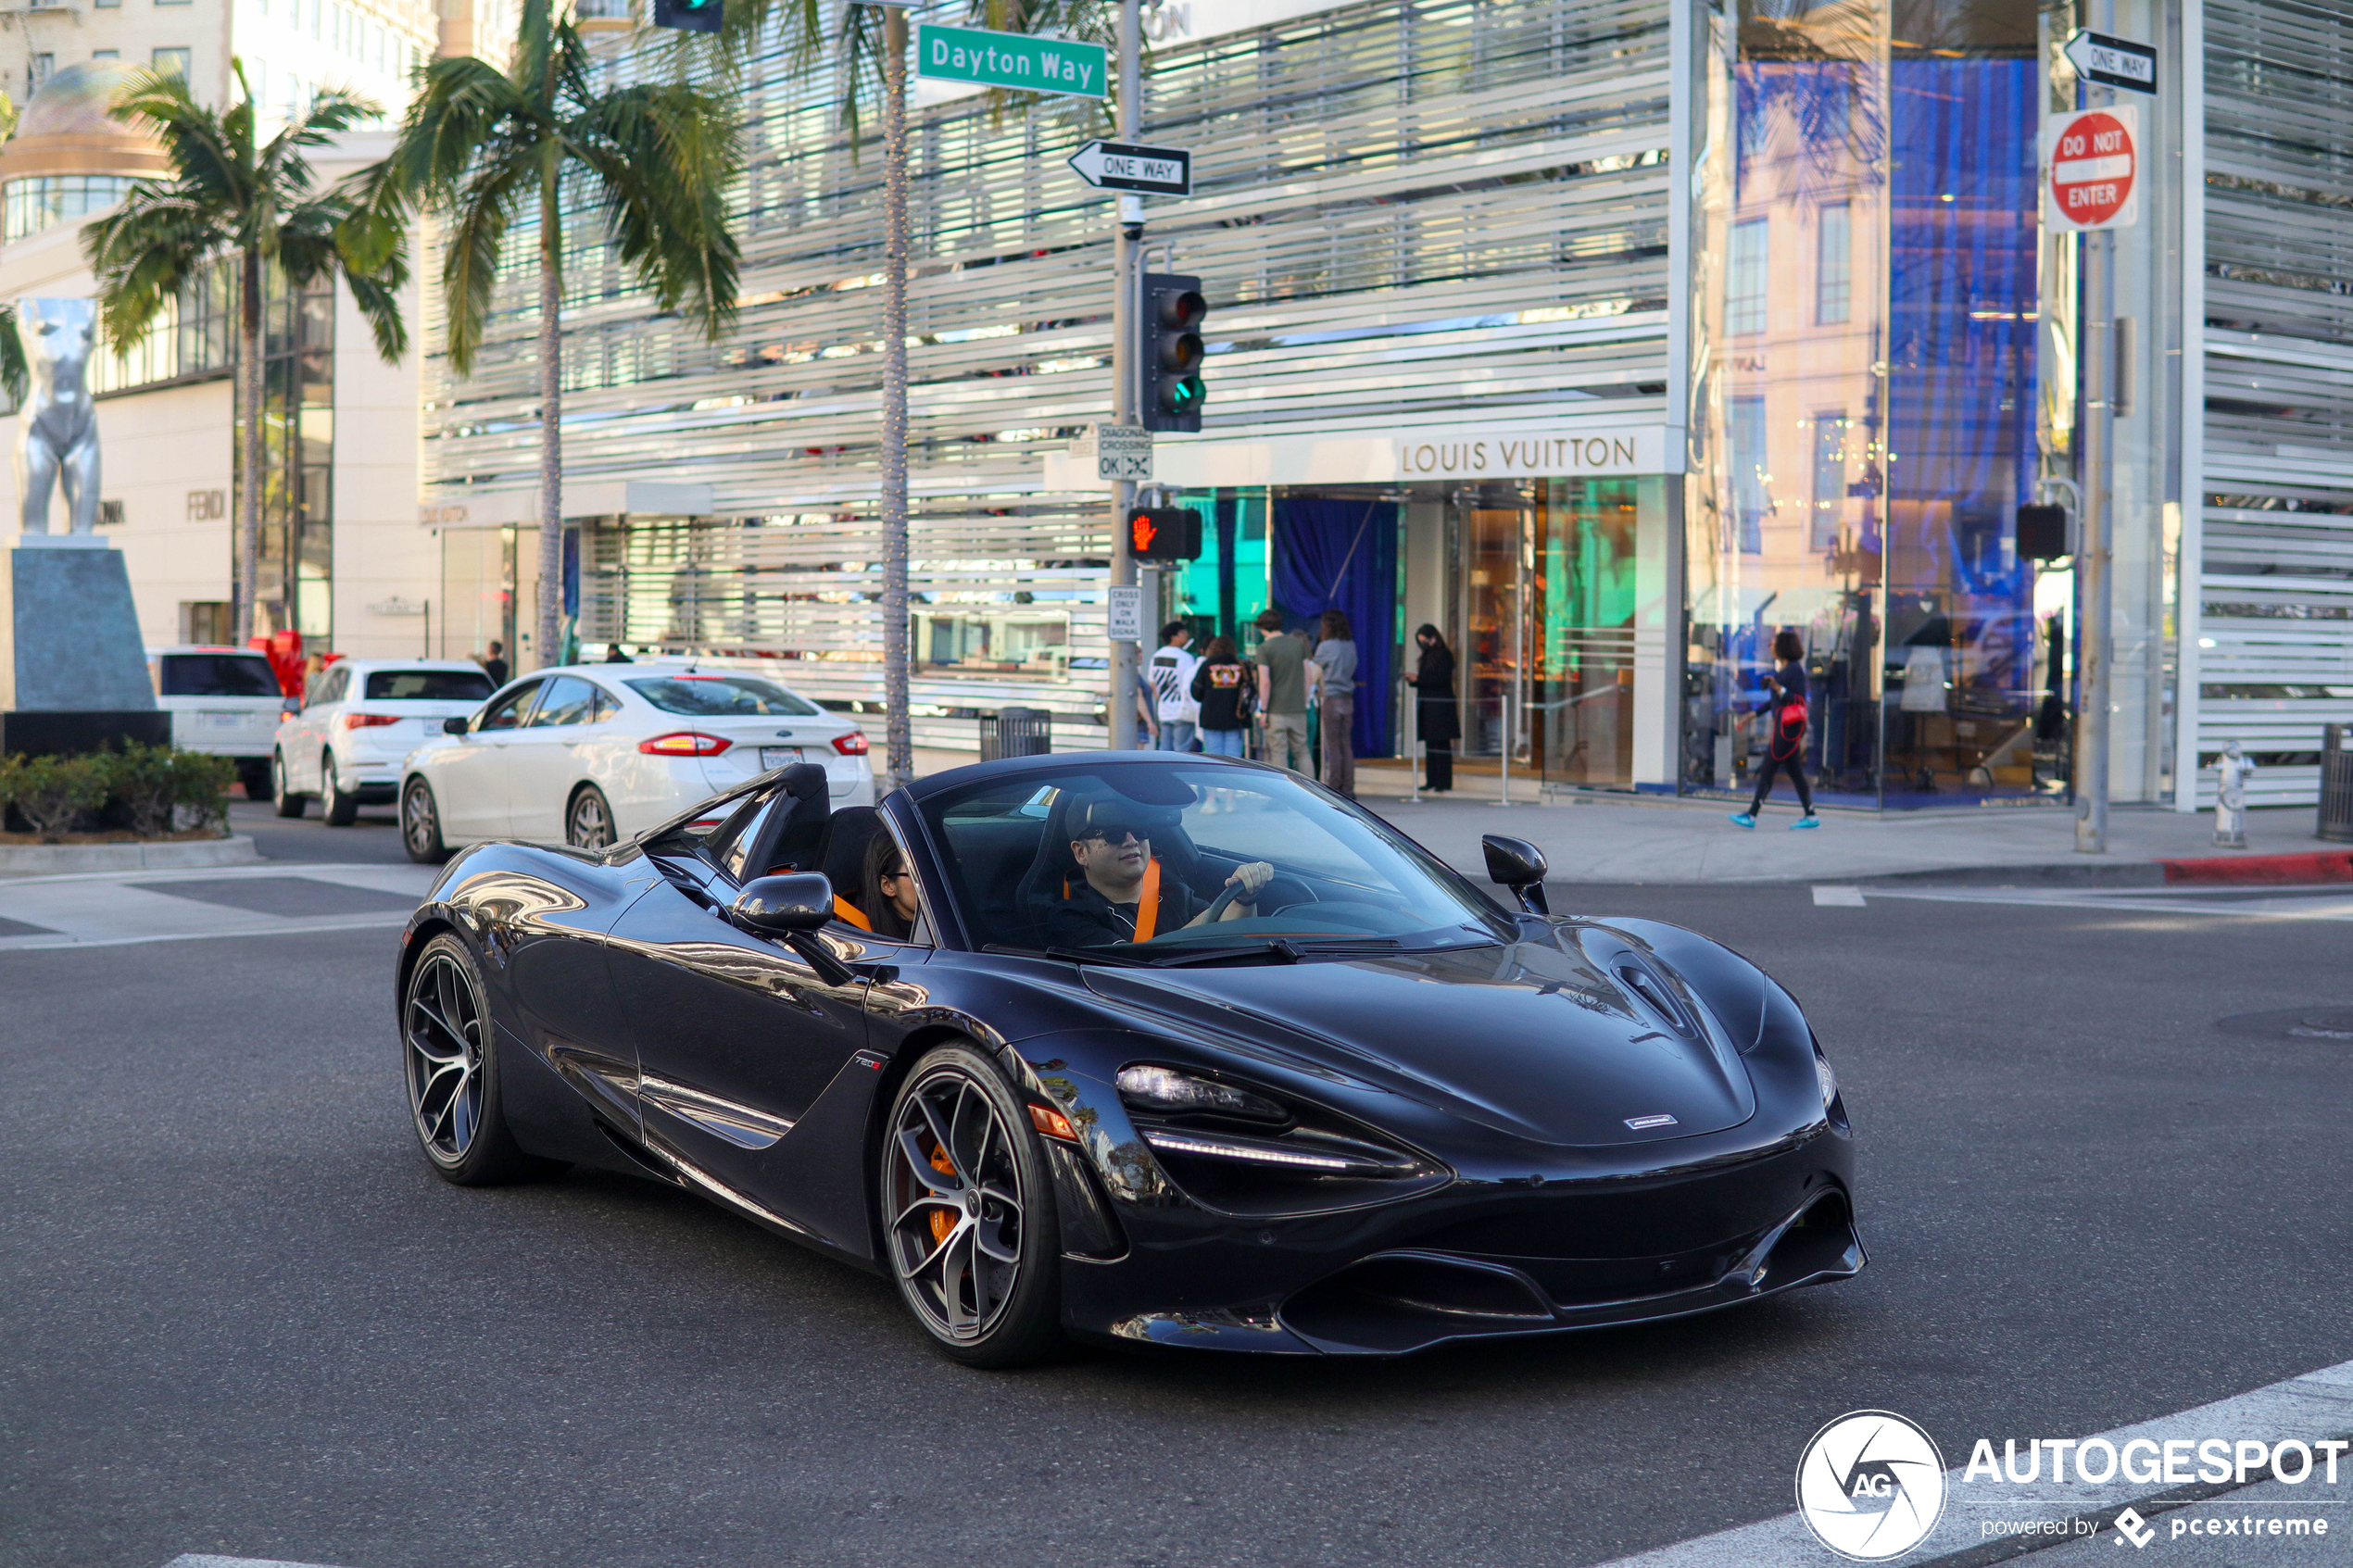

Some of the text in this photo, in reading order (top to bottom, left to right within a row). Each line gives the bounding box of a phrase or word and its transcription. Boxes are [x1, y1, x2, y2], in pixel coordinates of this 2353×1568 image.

[932, 38, 1093, 90] Dayton Way
[2090, 47, 2146, 78] ONE WAY
[2063, 130, 2123, 157] DO NOT
[1104, 157, 1176, 180] ONE WAY
[2068, 183, 2118, 208] ENTER
[1101, 428, 1151, 438] DIAGONAL
[1101, 440, 1151, 450] CROSSING
[1403, 436, 1635, 473] LOUIS VUITTON
[1101, 457, 1119, 474] OK
[1112, 590, 1139, 599] CROSS
[1112, 627, 1139, 636] SIGNAL
[855, 1056, 882, 1071] 720S
